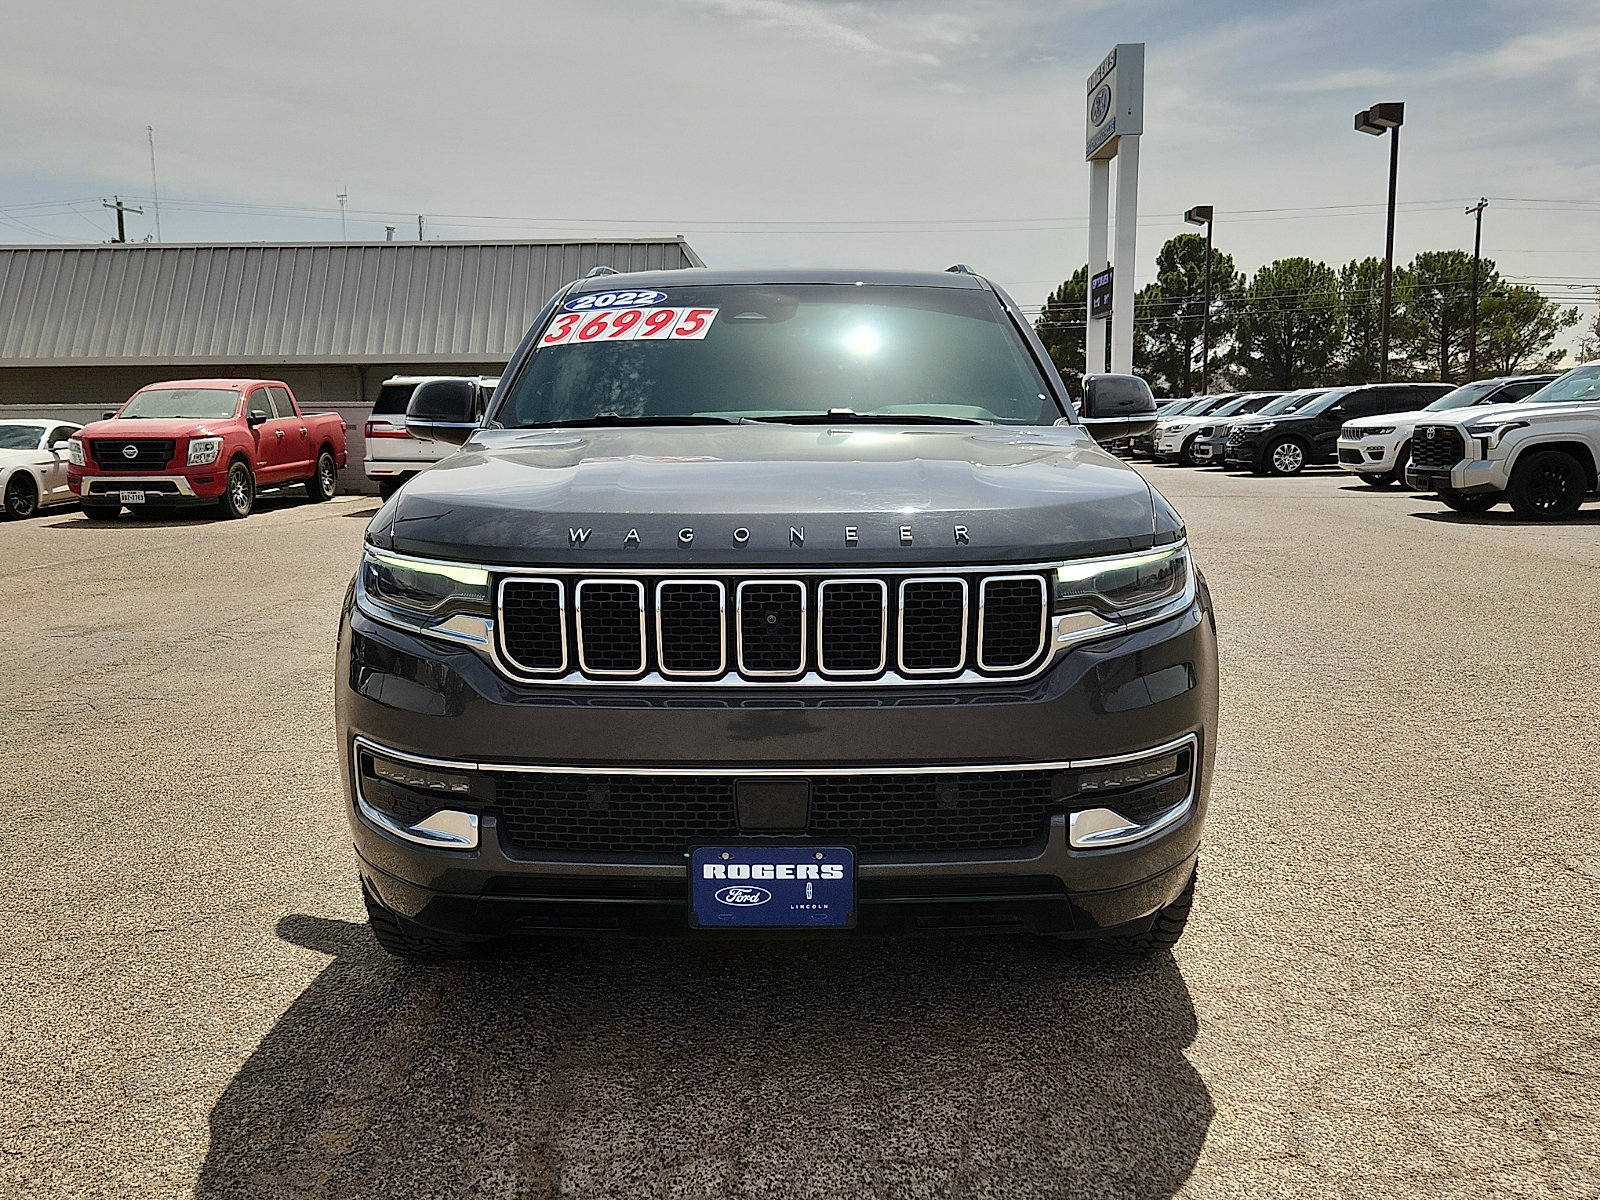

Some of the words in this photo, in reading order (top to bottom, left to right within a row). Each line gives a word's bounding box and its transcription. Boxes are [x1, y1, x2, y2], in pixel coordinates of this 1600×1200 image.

[572, 292, 654, 310] 2022
[544, 309, 714, 343] 36995
[568, 525, 970, 543] WAGONEER
[702, 863, 844, 880] ROGERS
[725, 888, 761, 903] Ford
